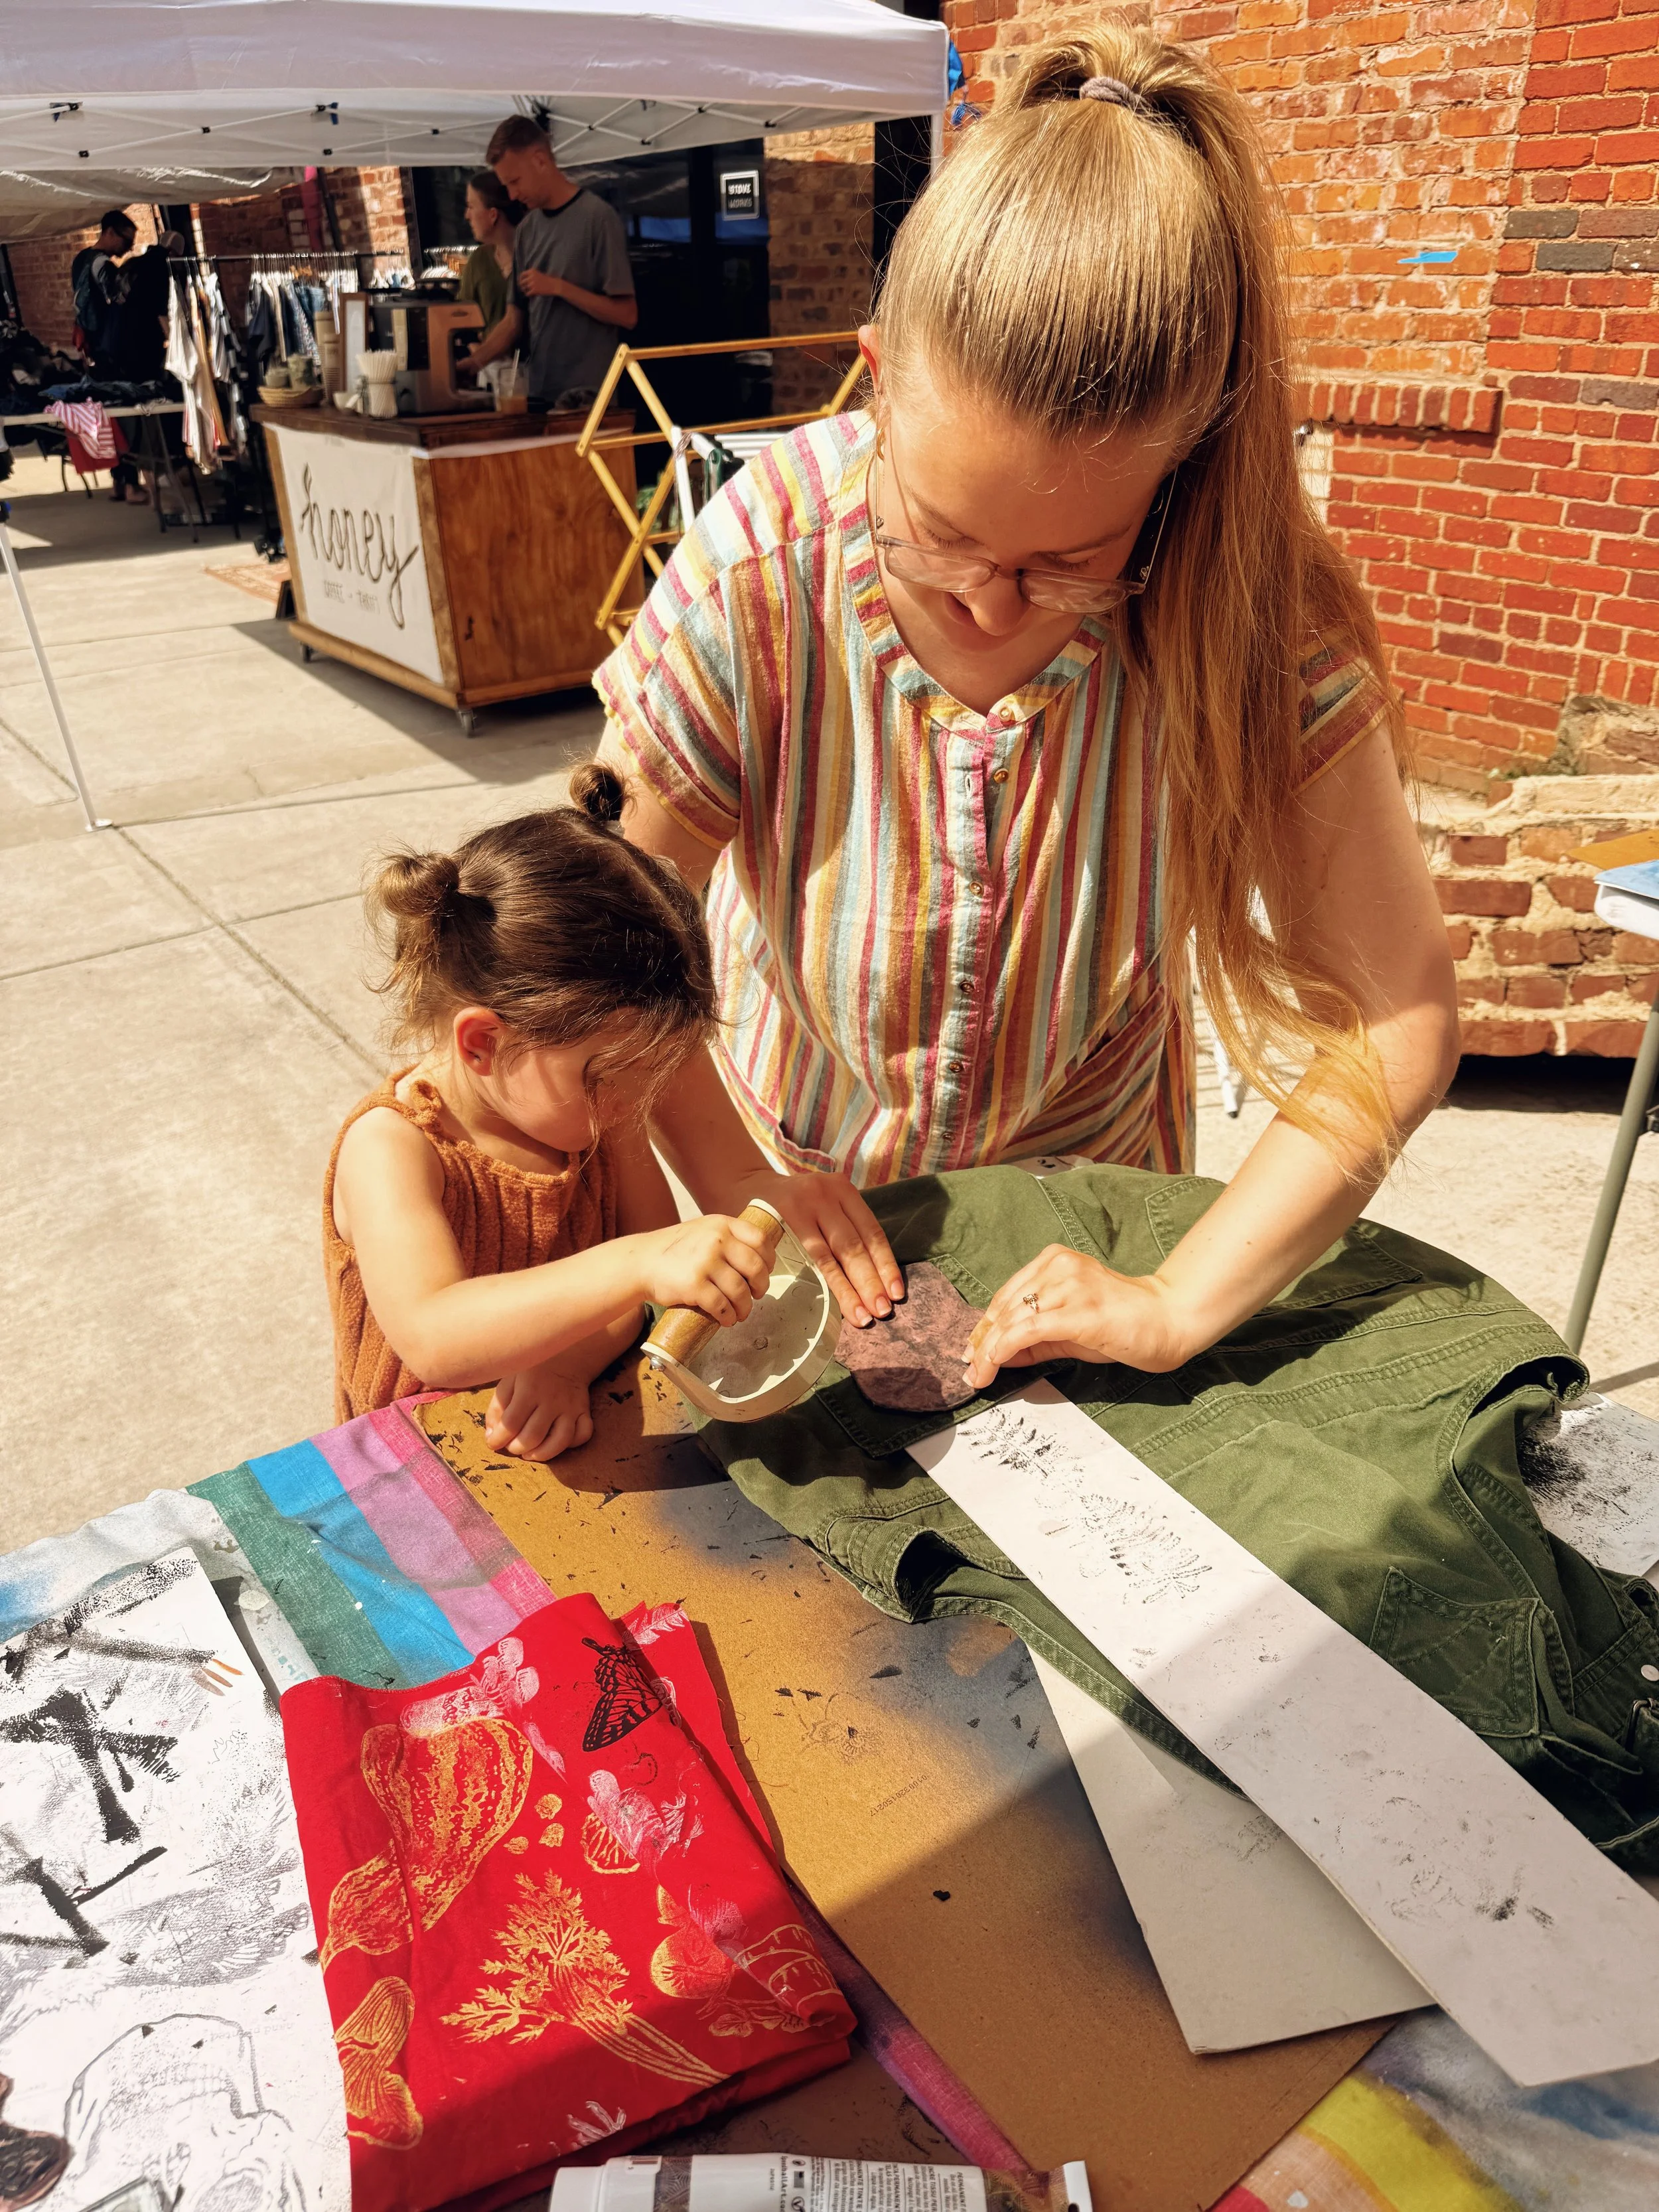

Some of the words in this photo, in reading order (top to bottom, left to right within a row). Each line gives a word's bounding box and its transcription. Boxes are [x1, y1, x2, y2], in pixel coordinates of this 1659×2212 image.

[728, 183, 751, 194] STOVE
[728, 198, 752, 208] WORKS
[301, 463, 419, 629] honey
[957, 2172, 966, 2207] PERMANENT
